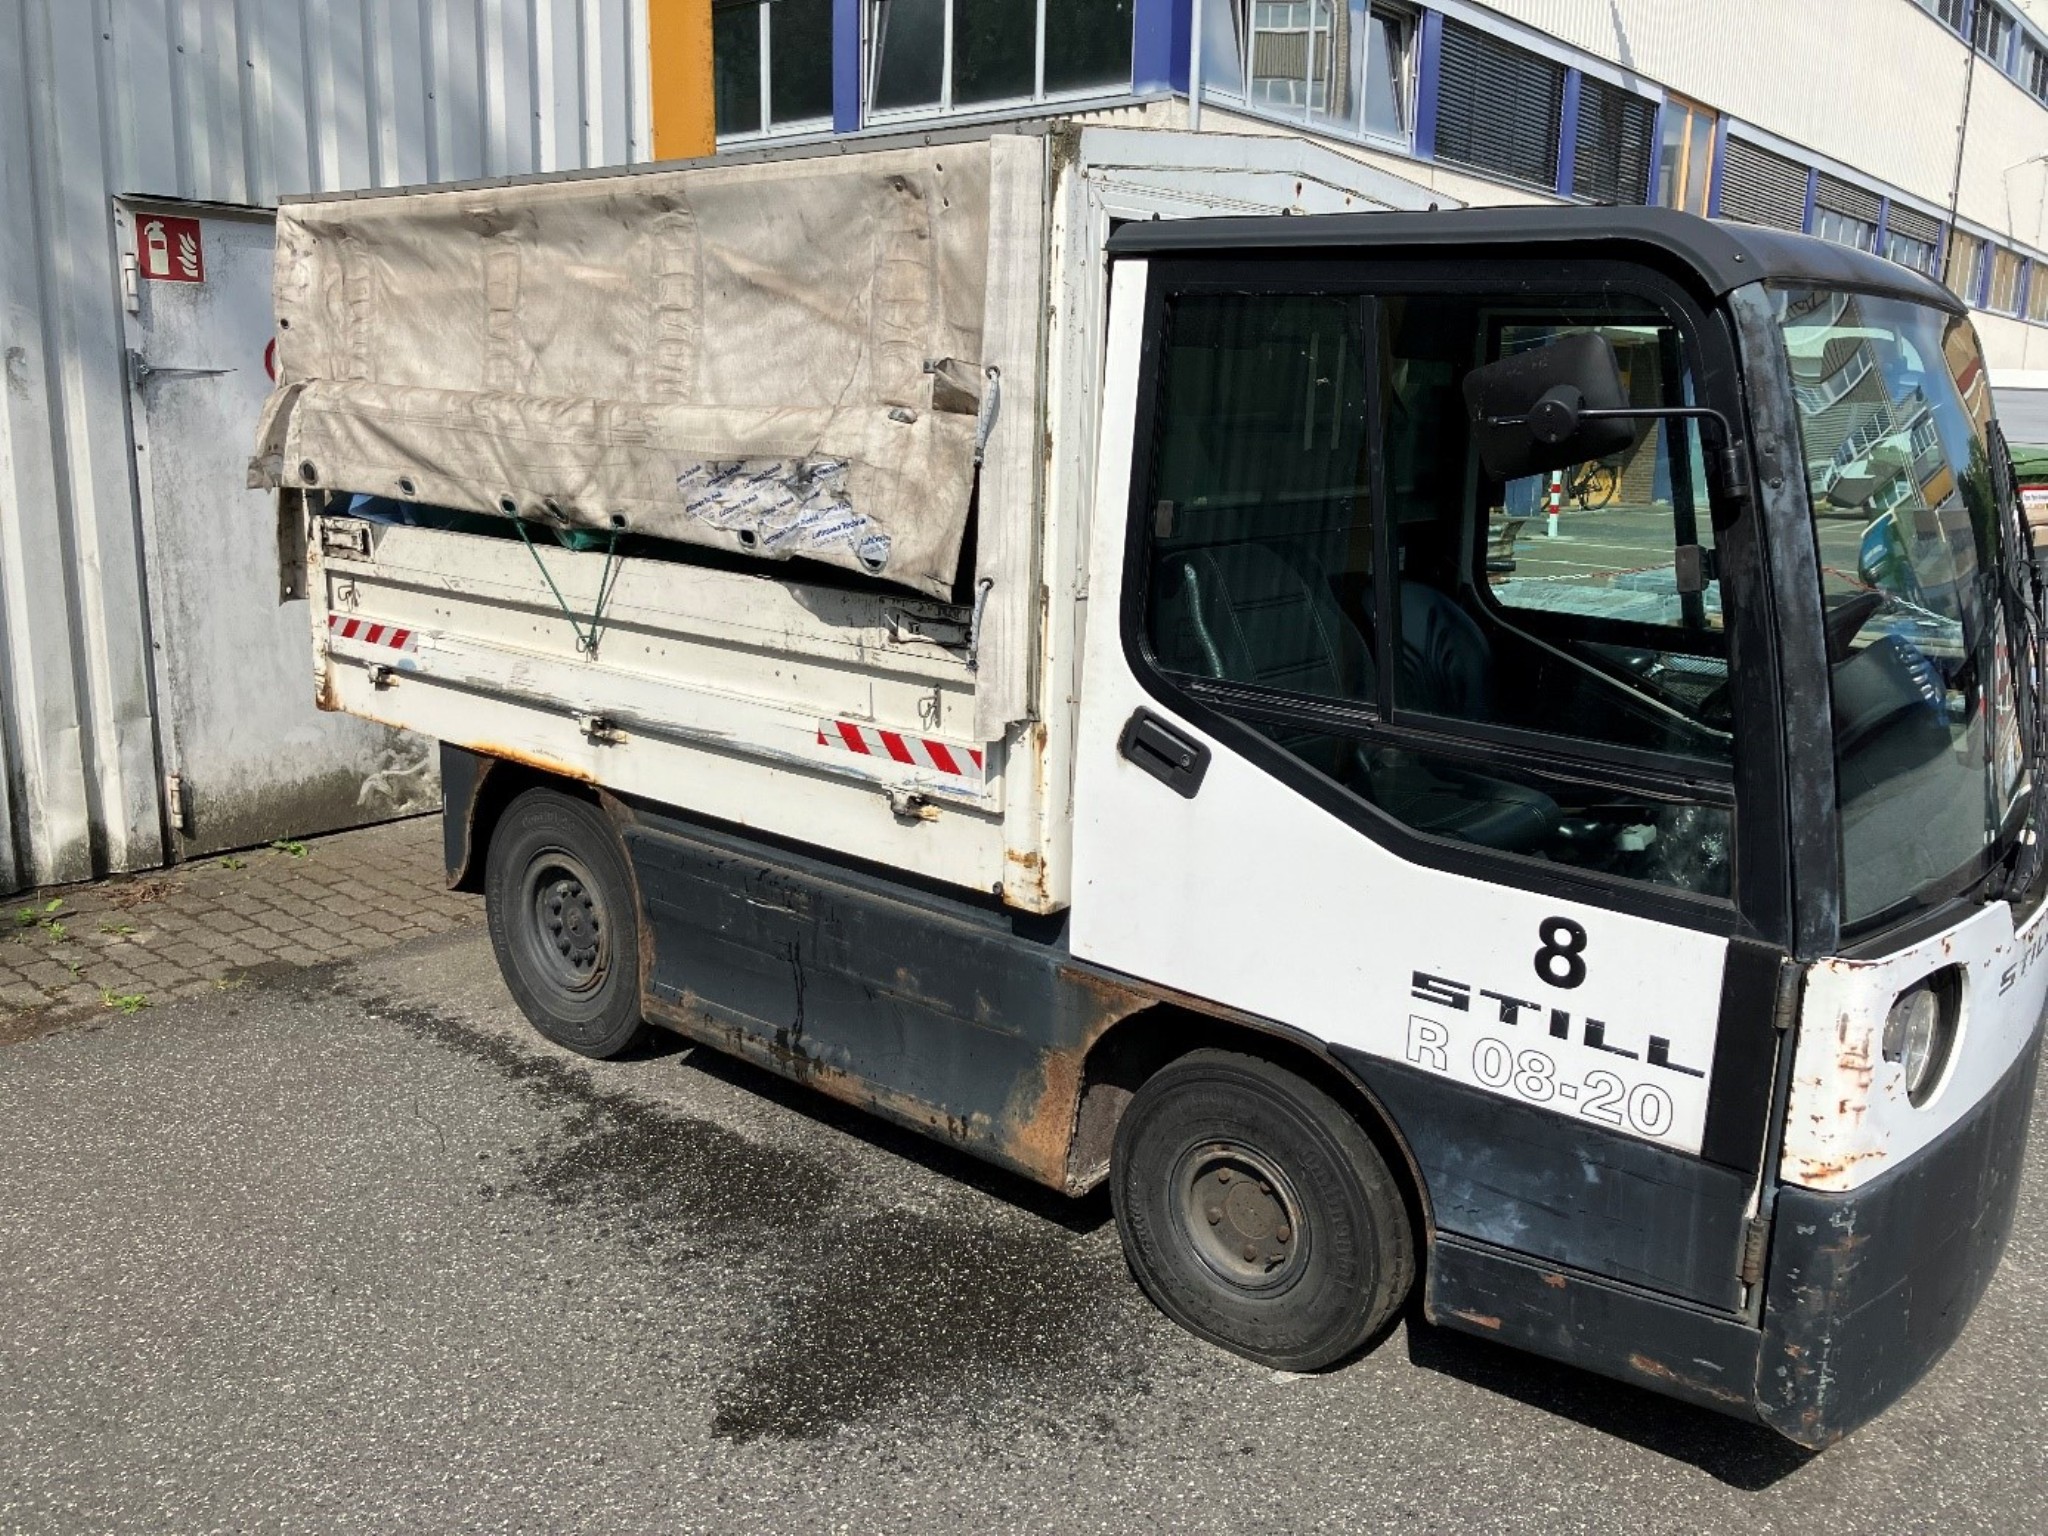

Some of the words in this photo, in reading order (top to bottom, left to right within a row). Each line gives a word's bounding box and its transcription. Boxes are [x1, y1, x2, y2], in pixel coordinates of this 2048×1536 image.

[1534, 915, 1588, 990] 8
[1406, 1014, 1449, 1071] R
[1472, 1037, 1674, 1137] 08-20
[1411, 970, 1706, 1079] STILL
